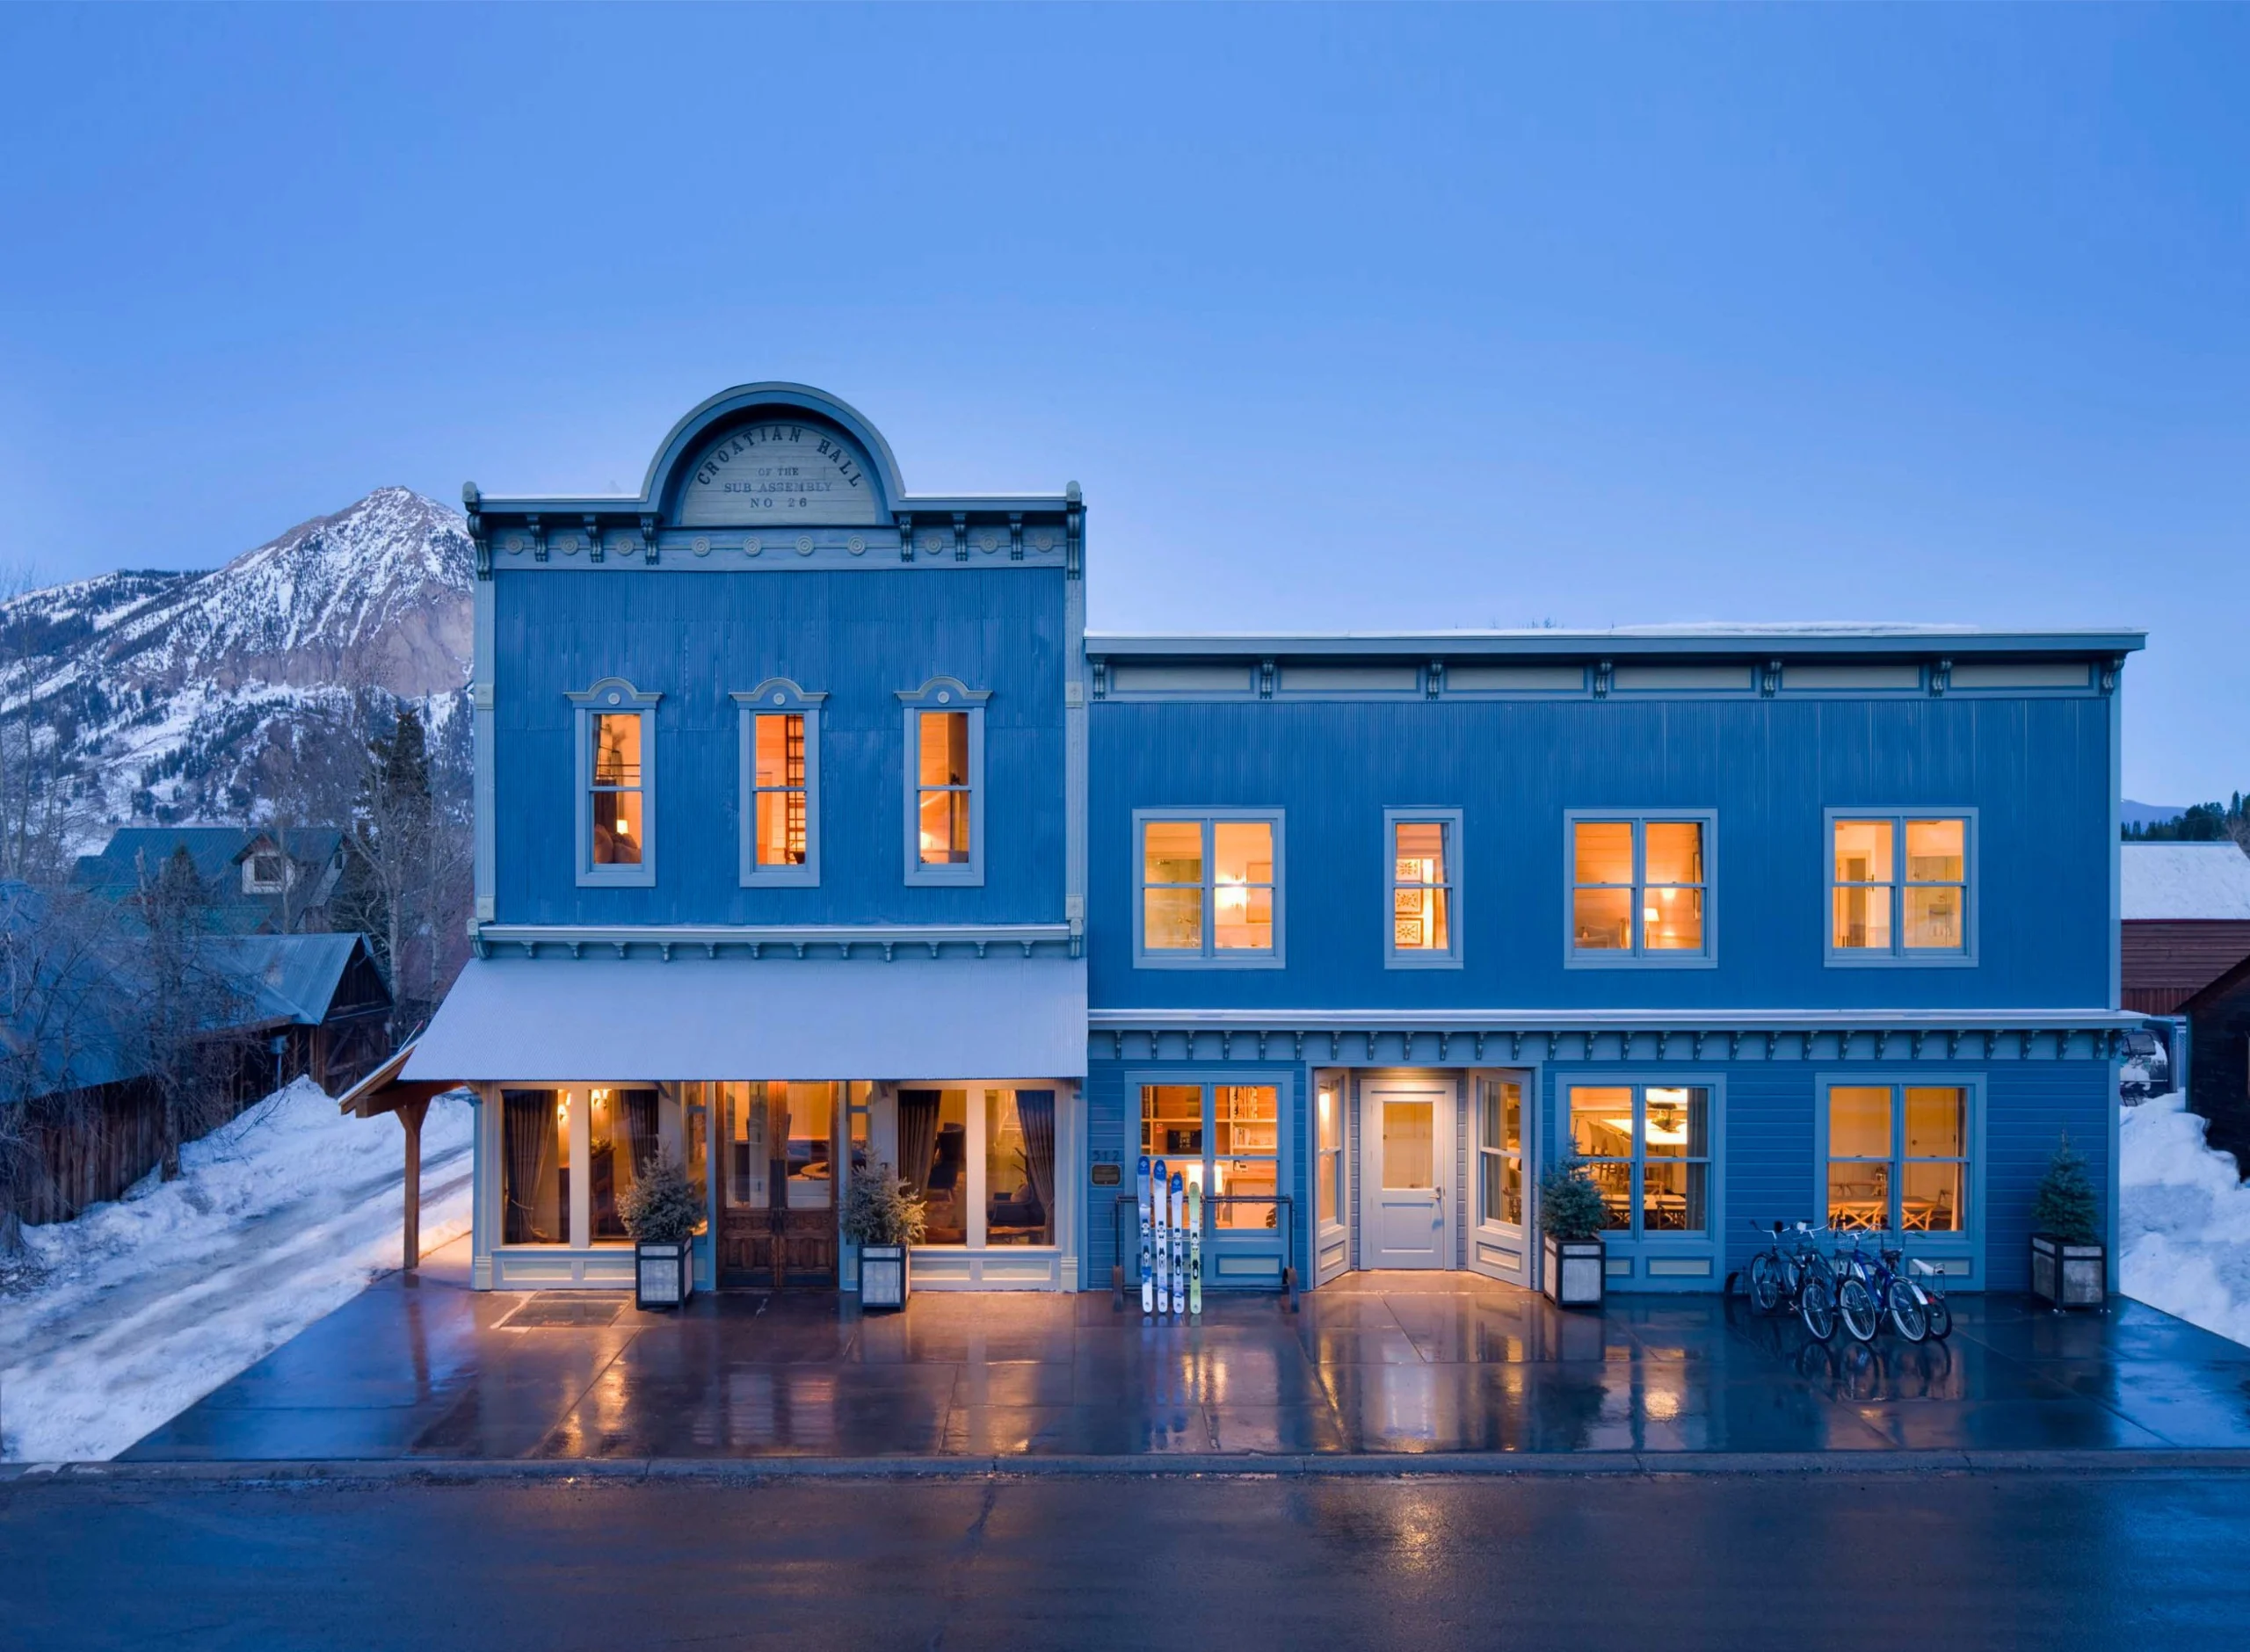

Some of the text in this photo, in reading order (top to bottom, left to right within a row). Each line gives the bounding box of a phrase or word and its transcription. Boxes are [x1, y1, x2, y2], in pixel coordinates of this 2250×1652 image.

[697, 425, 862, 488] CROATIAN HALL
[758, 467, 799, 476] OF THE
[723, 482, 832, 492] SUB ASSEMBLY
[751, 497, 807, 508] NO 26
